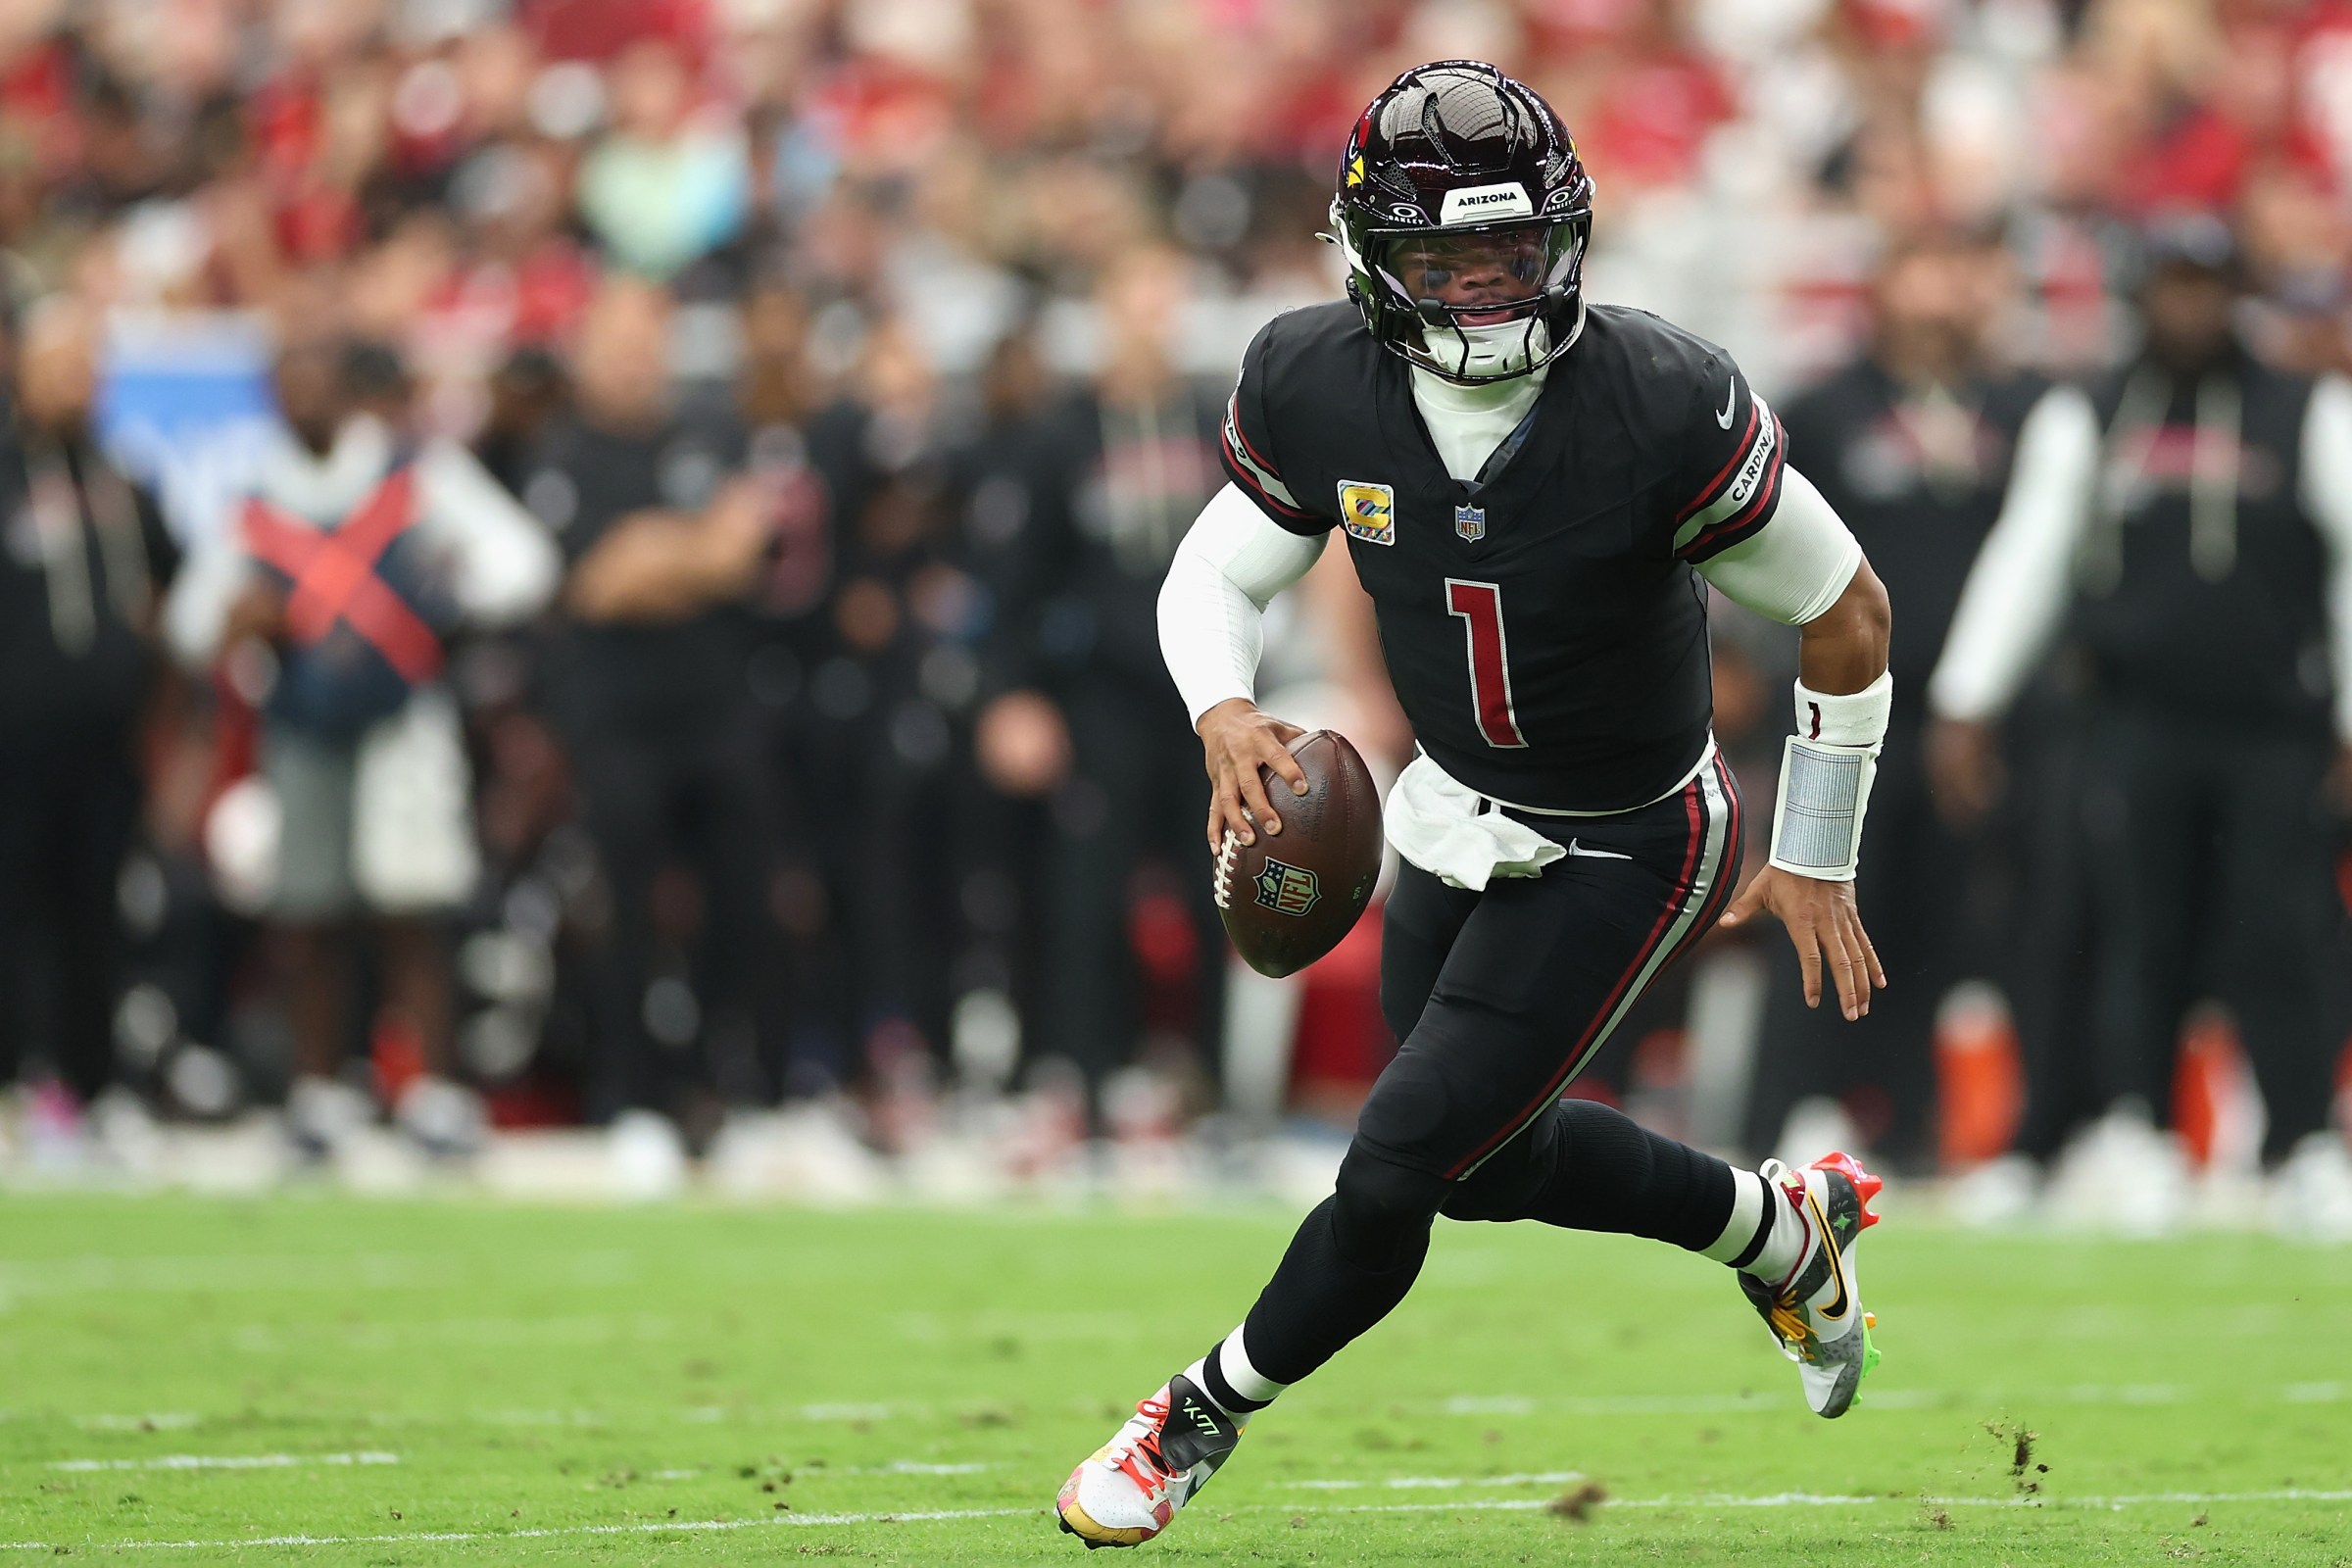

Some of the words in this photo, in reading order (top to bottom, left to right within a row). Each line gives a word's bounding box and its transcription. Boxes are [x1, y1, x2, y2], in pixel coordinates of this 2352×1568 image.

[1457, 192, 1517, 207] ARIZONA
[1546, 199, 1572, 213] OAKLEY
[1388, 215, 1424, 225] OAKLEY
[1343, 486, 1390, 529] C
[1460, 520, 1481, 535] NFL
[1445, 577, 1529, 748] 1
[1279, 872, 1311, 912] NFL
